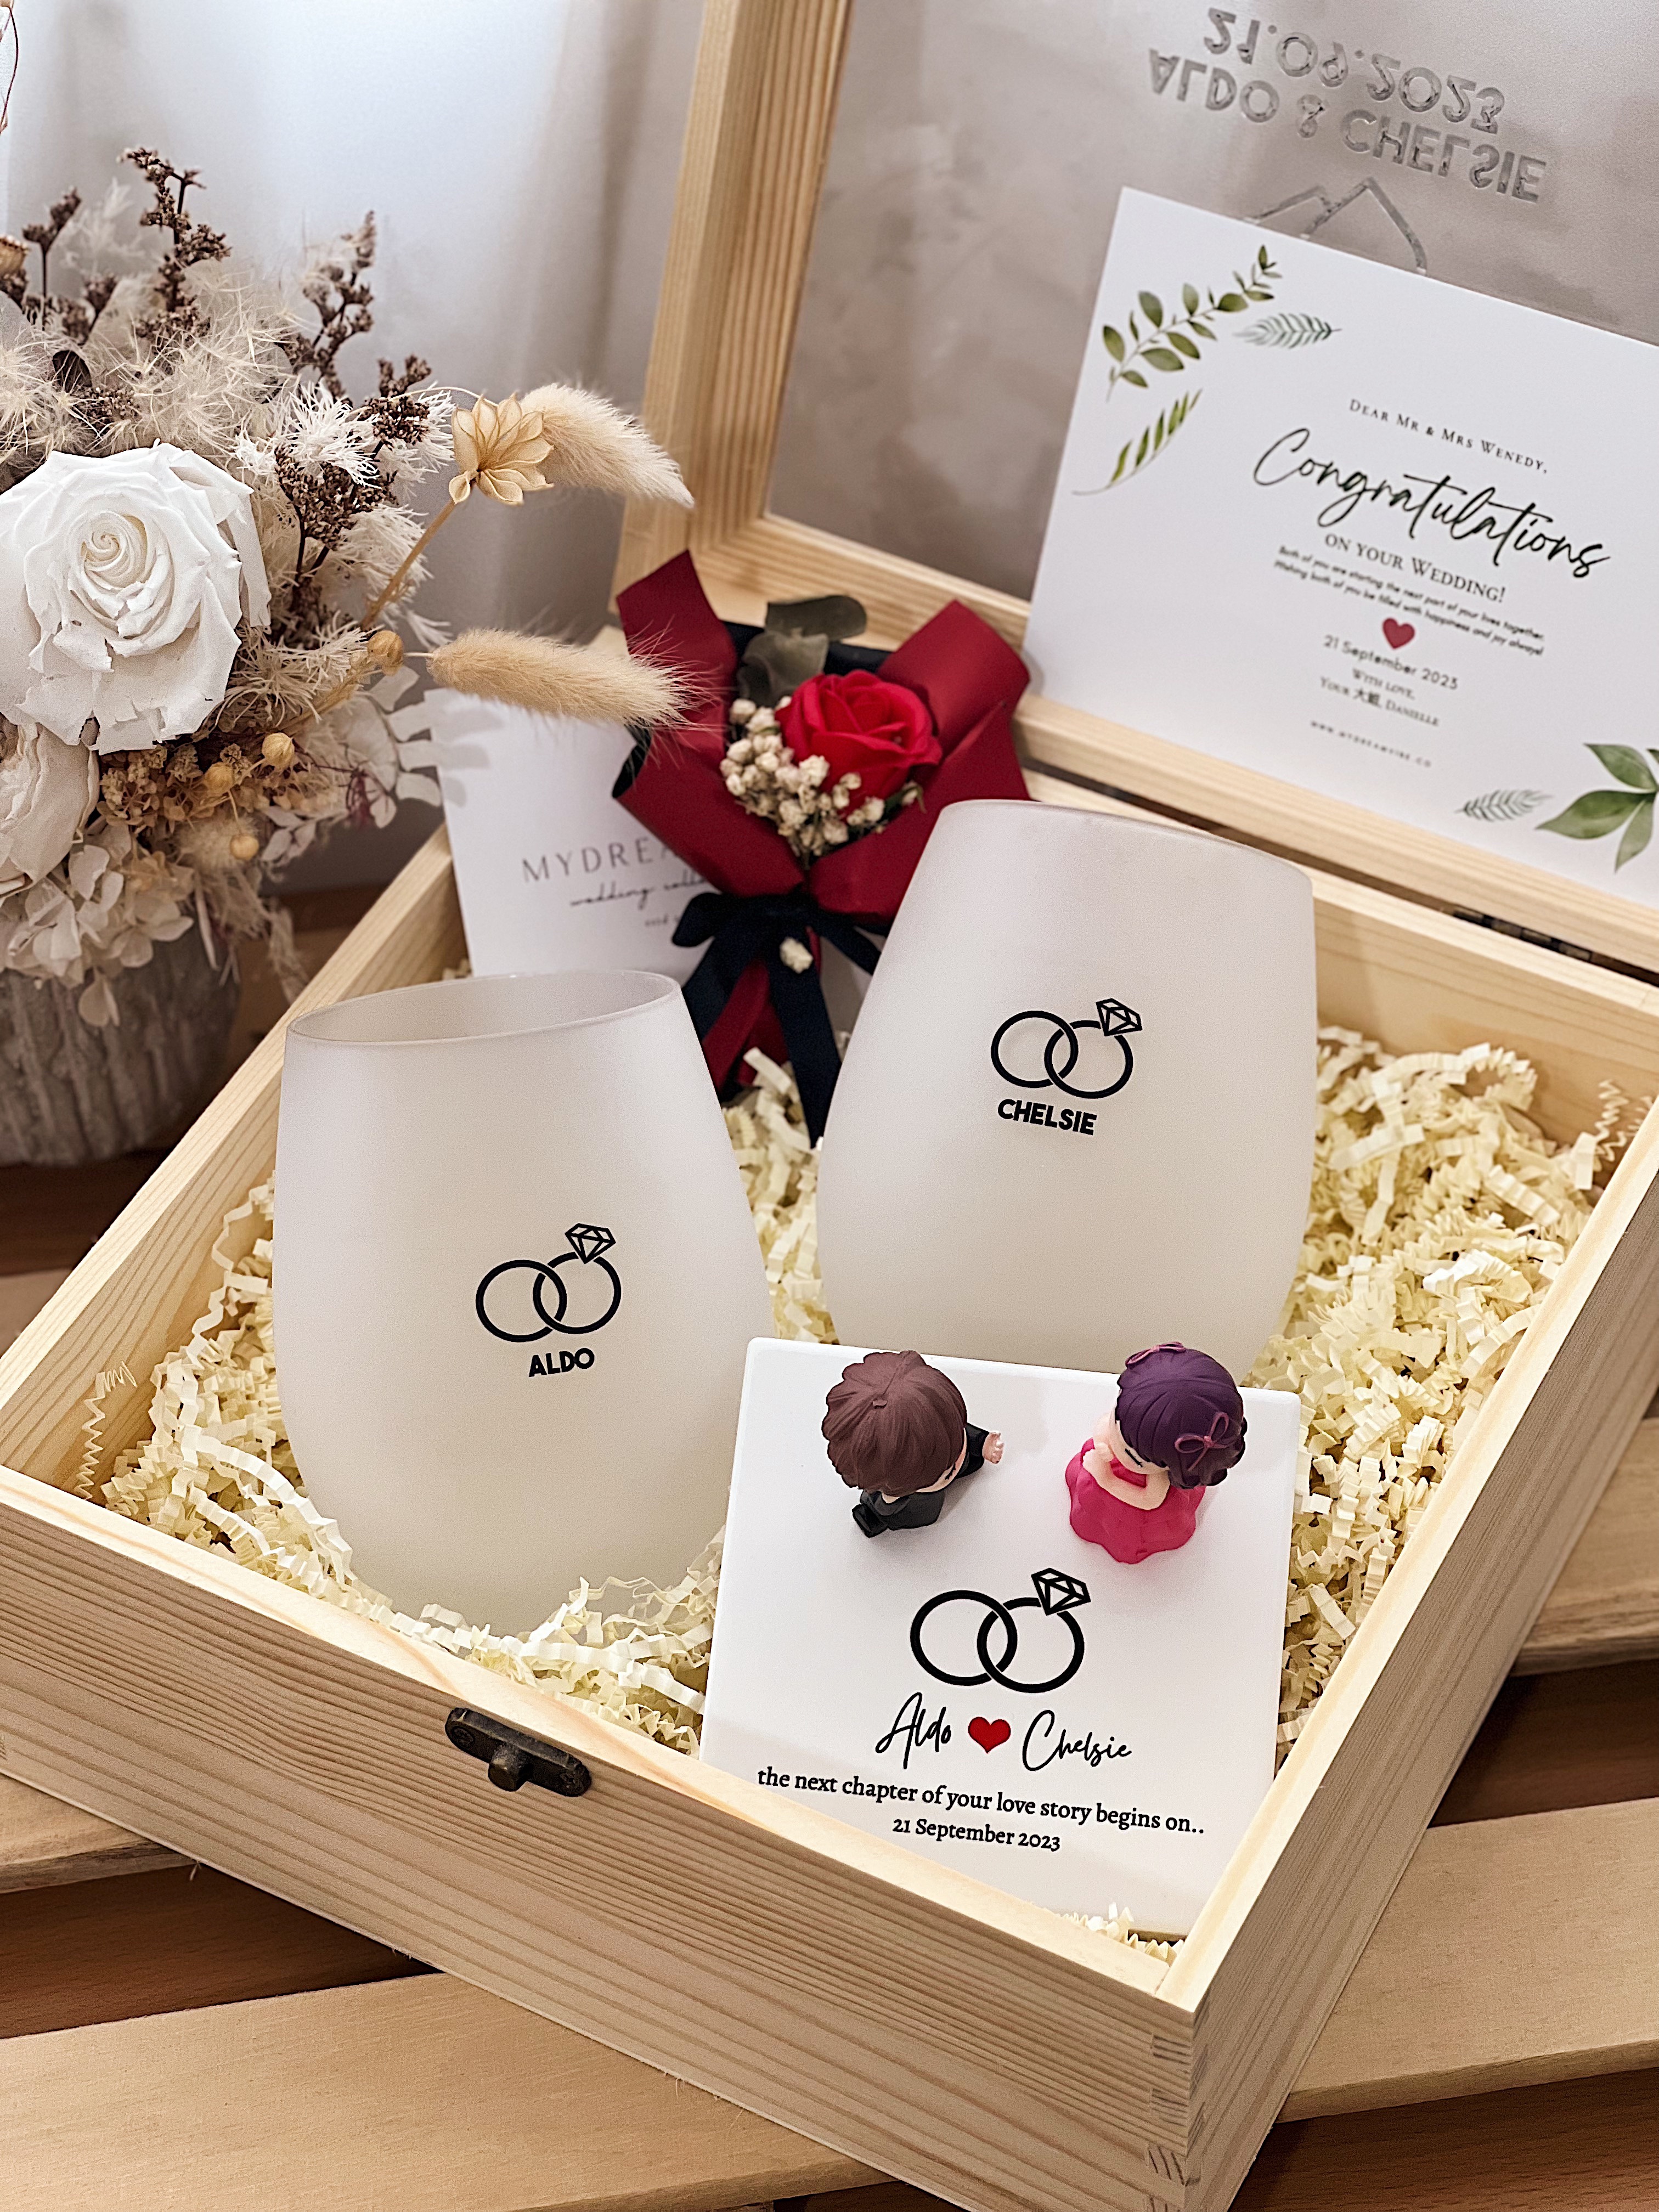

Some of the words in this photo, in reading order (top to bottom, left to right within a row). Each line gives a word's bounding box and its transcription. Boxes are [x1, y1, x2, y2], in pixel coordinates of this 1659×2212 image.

[1426, 426, 1435, 436] &
[1253, 428, 1611, 578] Congratulations
[1324, 635, 1340, 649] 21
[1342, 641, 1417, 675] September
[997, 1098, 1098, 1136] CHELSIE
[528, 1347, 595, 1378] ALDO
[875, 1691, 952, 1770] Aldo
[1022, 1709, 1132, 1771] Chelsie
[758, 1766, 790, 1787] the
[794, 1774, 838, 1793] next
[842, 1776, 918, 1804] chapter
[922, 1784, 947, 1804] of
[946, 1792, 992, 1810] your
[997, 1792, 1036, 1815] love
[1040, 1801, 1092, 1826] story
[1096, 1803, 1160, 1831] begins
[1165, 1816, 1205, 1835] on..
[893, 1818, 911, 1834] 21
[916, 1819, 1015, 1844] September
[1018, 1834, 1062, 1852] 2023
